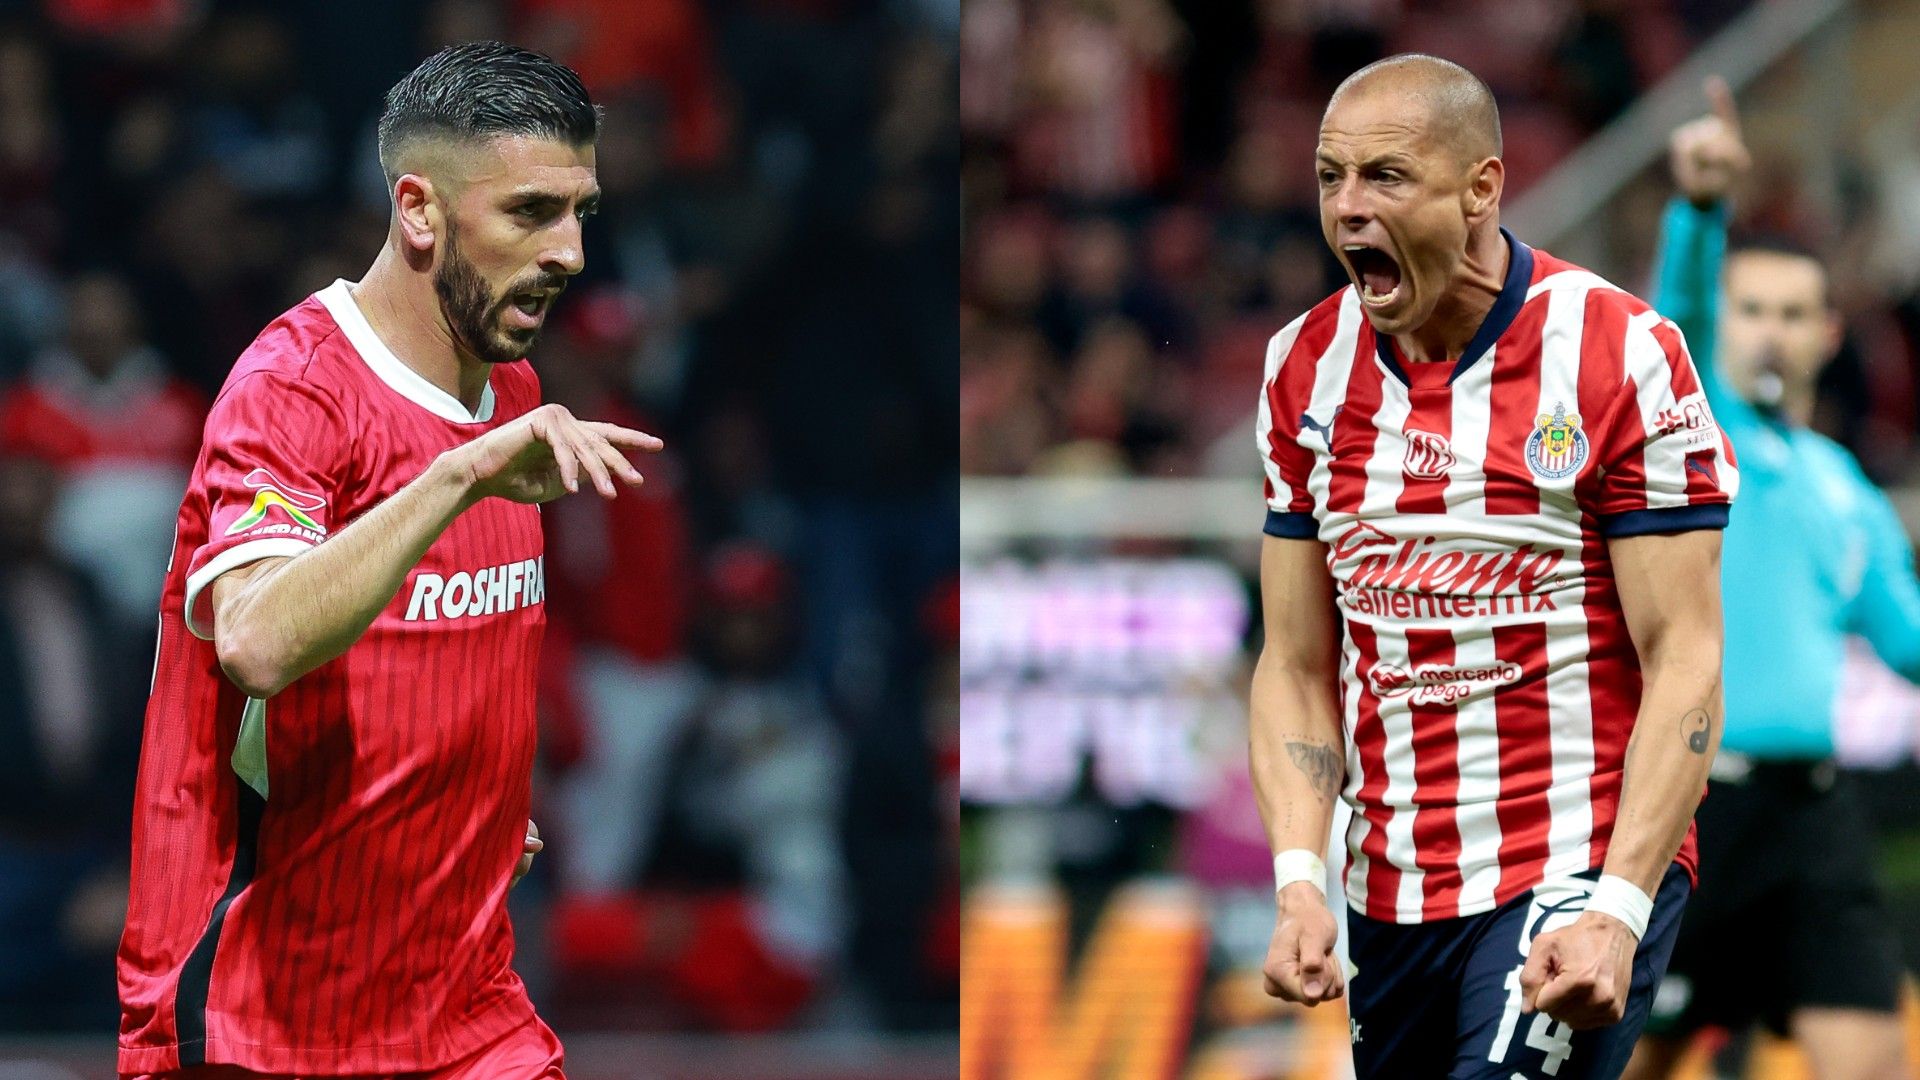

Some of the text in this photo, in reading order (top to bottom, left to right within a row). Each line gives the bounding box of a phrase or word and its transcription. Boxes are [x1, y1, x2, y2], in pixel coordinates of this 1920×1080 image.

[1420, 665, 1516, 682] mercado
[1421, 684, 1471, 702] pago
[1488, 964, 1574, 1077] 14
